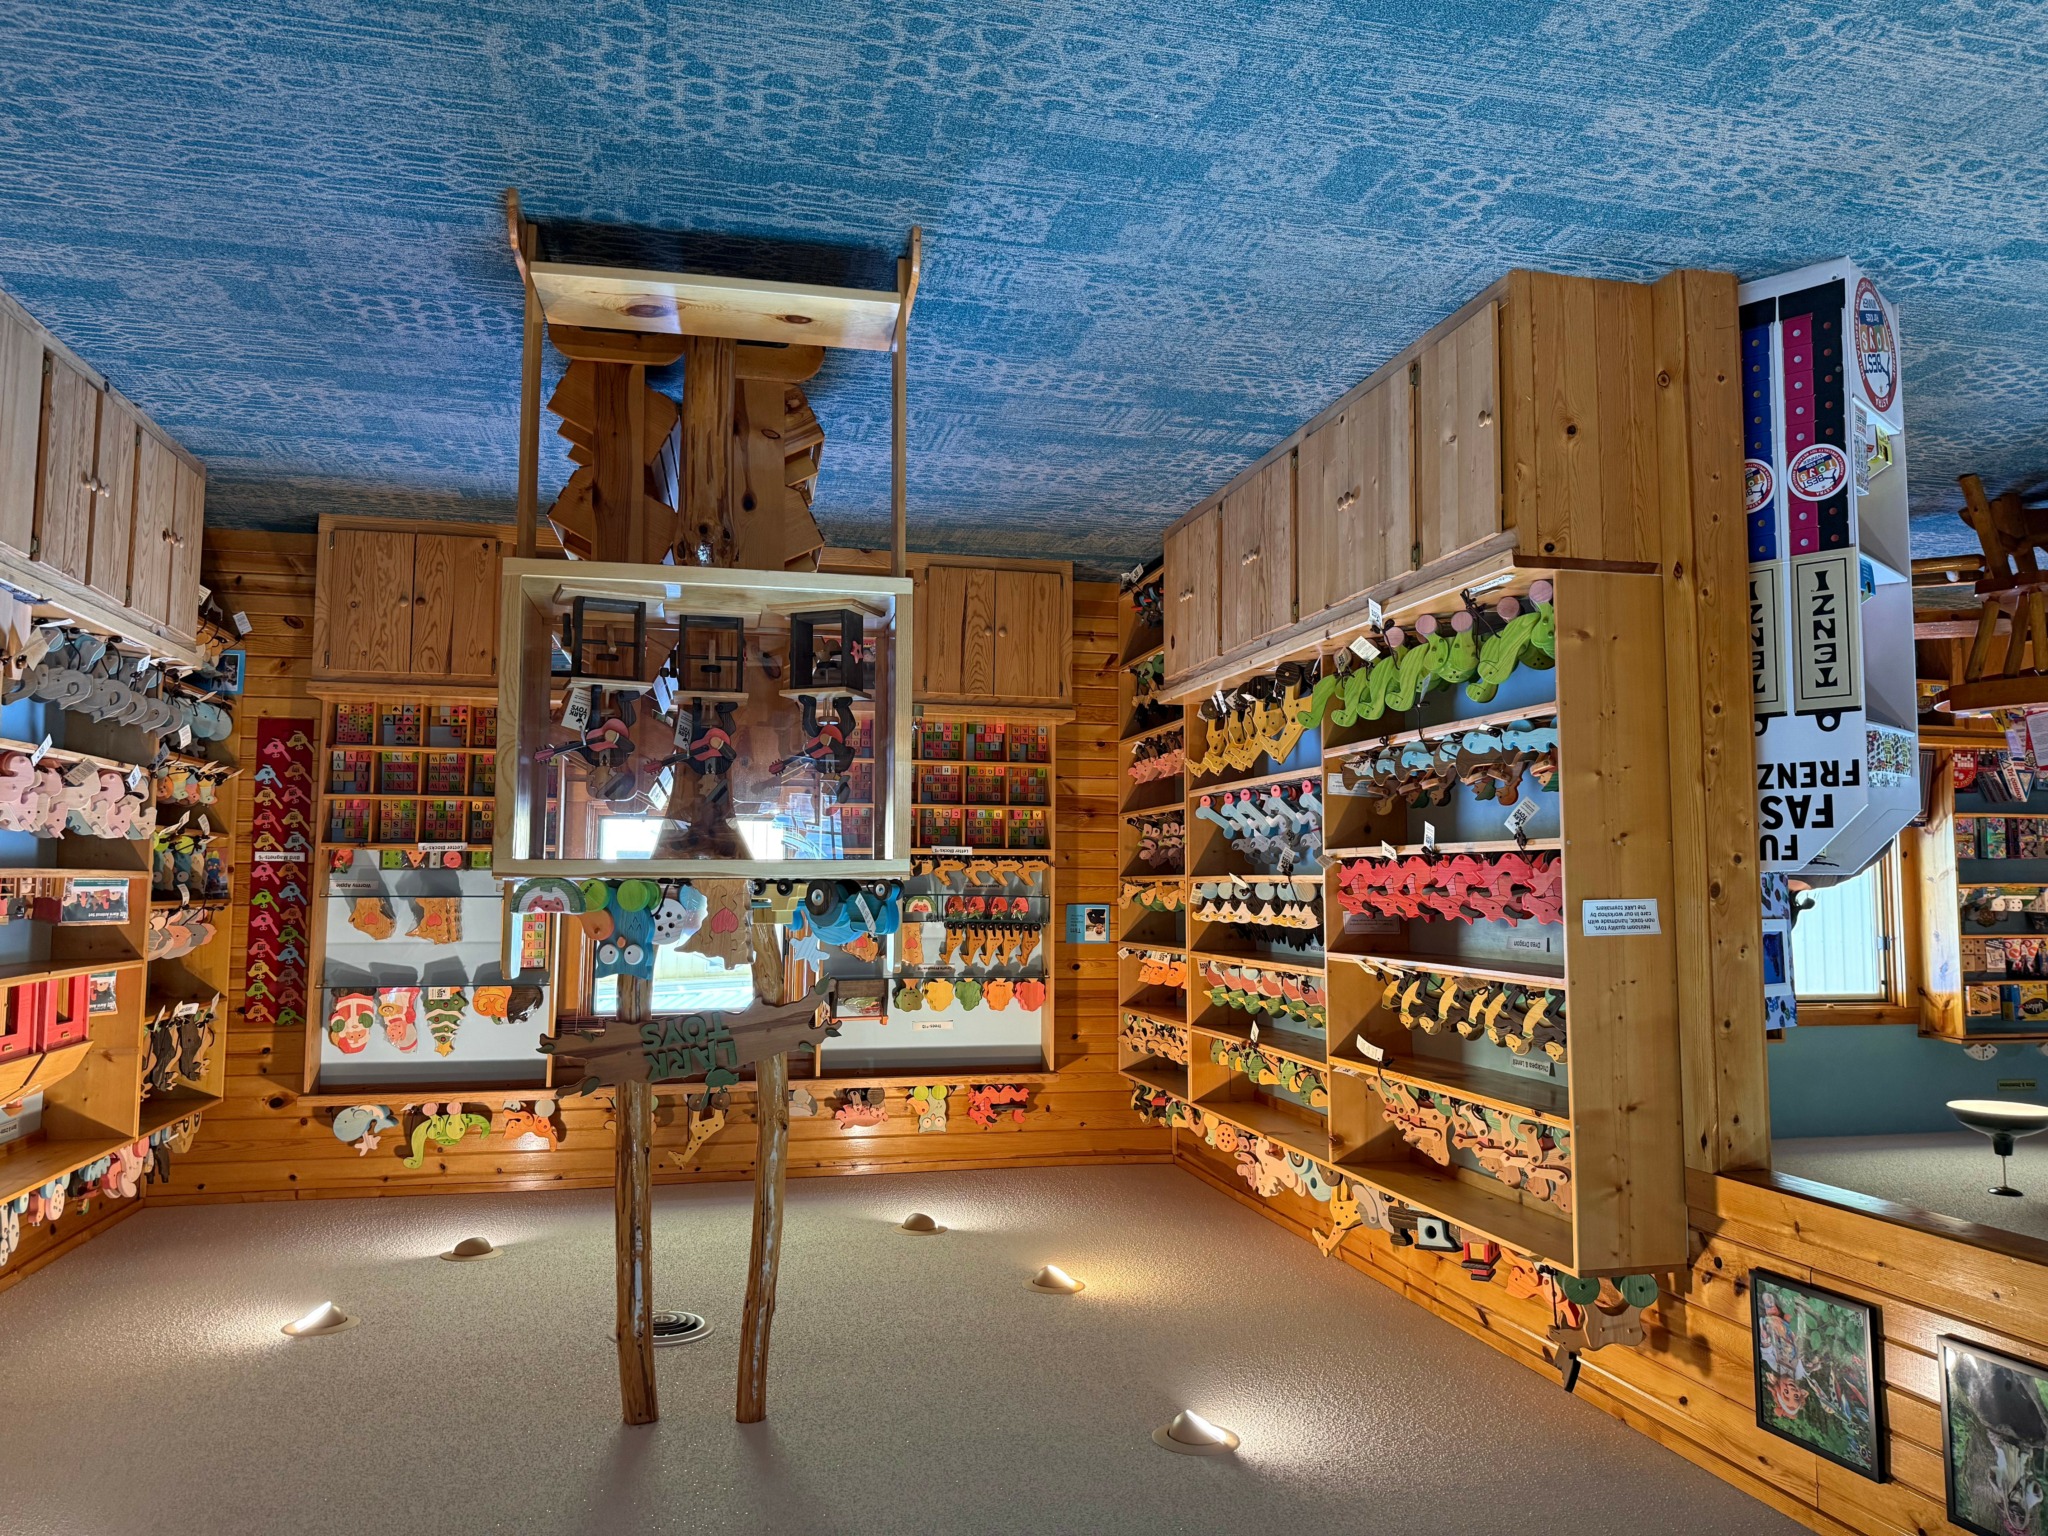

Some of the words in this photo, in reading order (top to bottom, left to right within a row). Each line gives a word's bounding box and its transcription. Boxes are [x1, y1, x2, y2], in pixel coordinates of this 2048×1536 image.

[1863, 298, 1877, 309] WINNER
[1865, 313, 1874, 323] Kids
[1864, 353, 1881, 374] BEST
[1875, 395, 1889, 406] ASTRA
[1803, 453, 1824, 464] WINNER
[1802, 474, 1824, 489] BEST
[1816, 486, 1833, 496] ASTRA
[1812, 570, 1838, 688] TENZI
[569, 709, 587, 719] LARK
[571, 704, 588, 713] TOYS
[1757, 759, 1860, 789] FRENZ
[1757, 794, 1834, 830] FAS
[1760, 834, 1798, 861] FU
[1513, 940, 1529, 948] Dragon
[639, 1013, 730, 1050] TOYS
[643, 1039, 737, 1081] LARK
